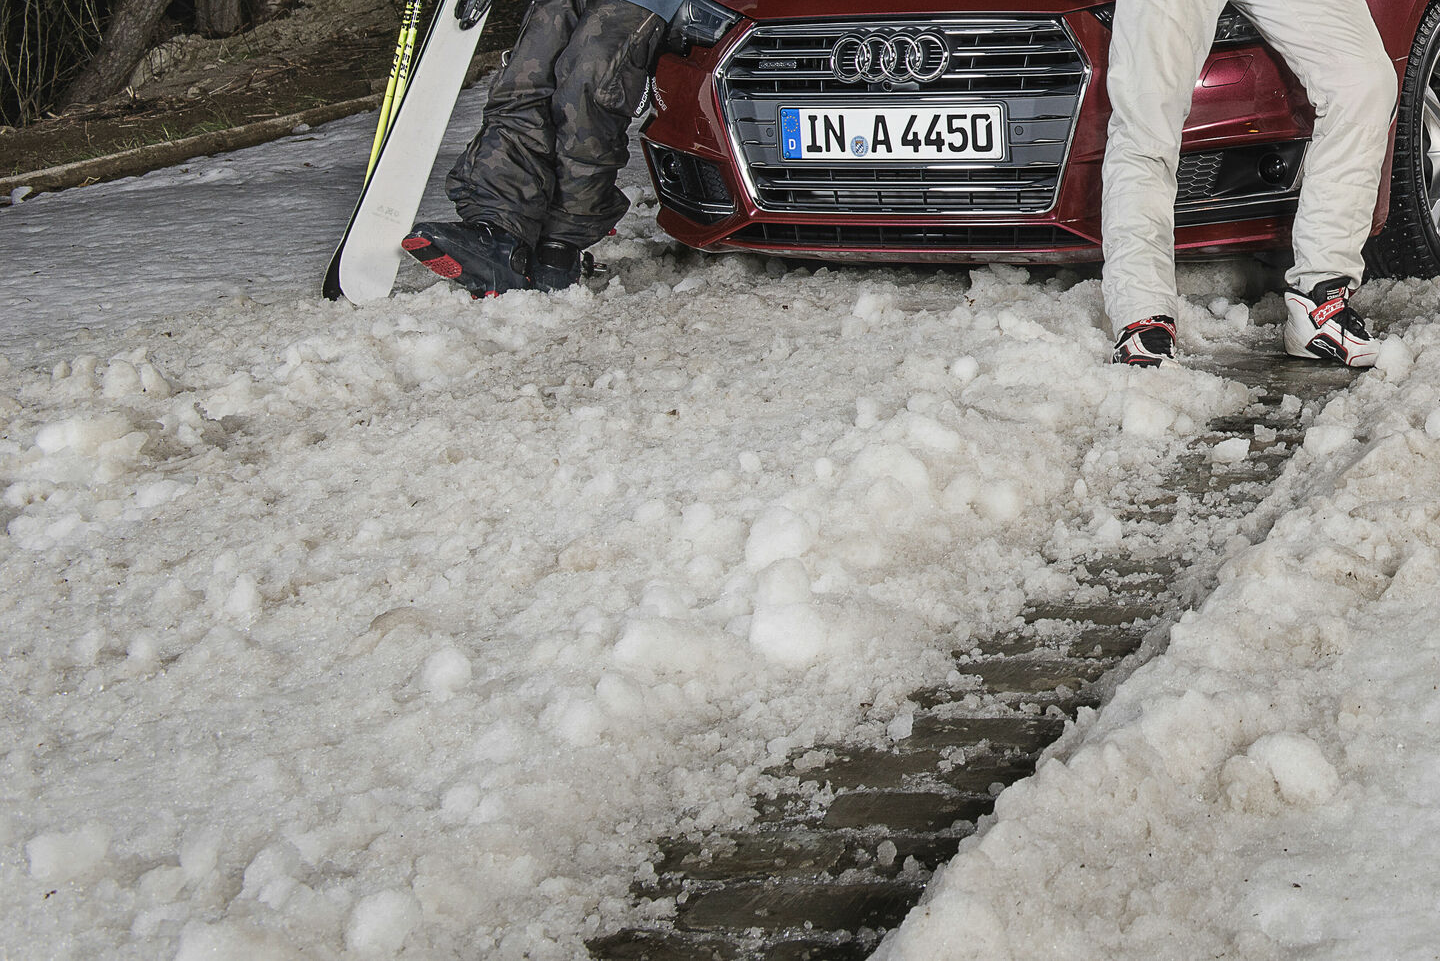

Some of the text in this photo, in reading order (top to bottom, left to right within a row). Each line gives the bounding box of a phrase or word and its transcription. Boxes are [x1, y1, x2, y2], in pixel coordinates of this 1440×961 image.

[788, 113, 993, 153] D IN A 4450
